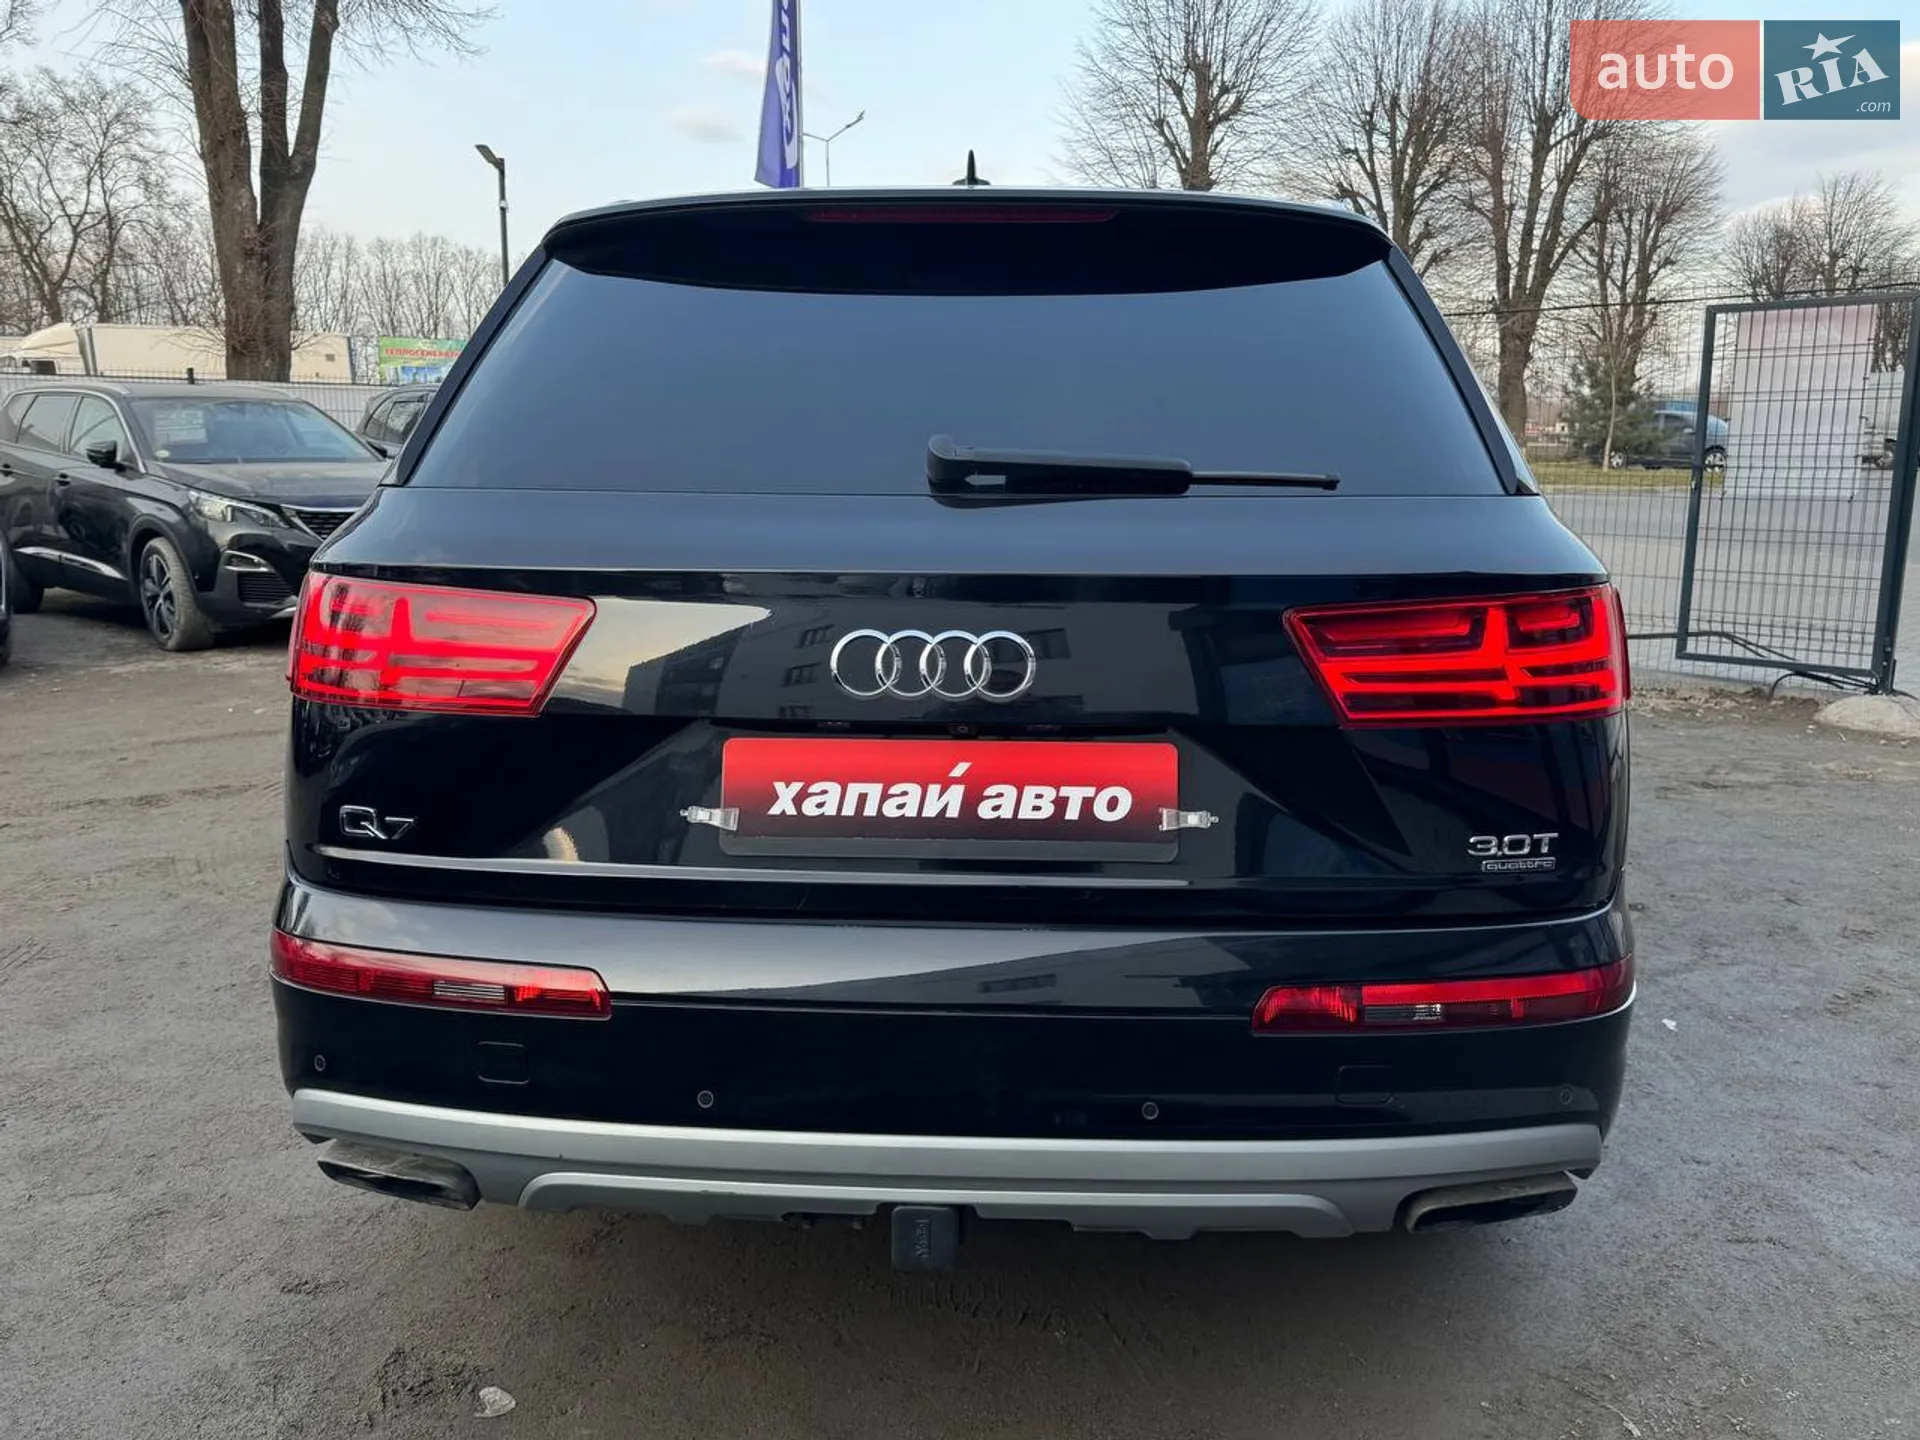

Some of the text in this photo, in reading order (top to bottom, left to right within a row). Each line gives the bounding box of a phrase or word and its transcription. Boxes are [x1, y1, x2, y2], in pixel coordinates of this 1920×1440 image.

[976, 783, 1133, 822] авто
[339, 804, 416, 840] Q7
[1467, 832, 1559, 857] 3.0T
